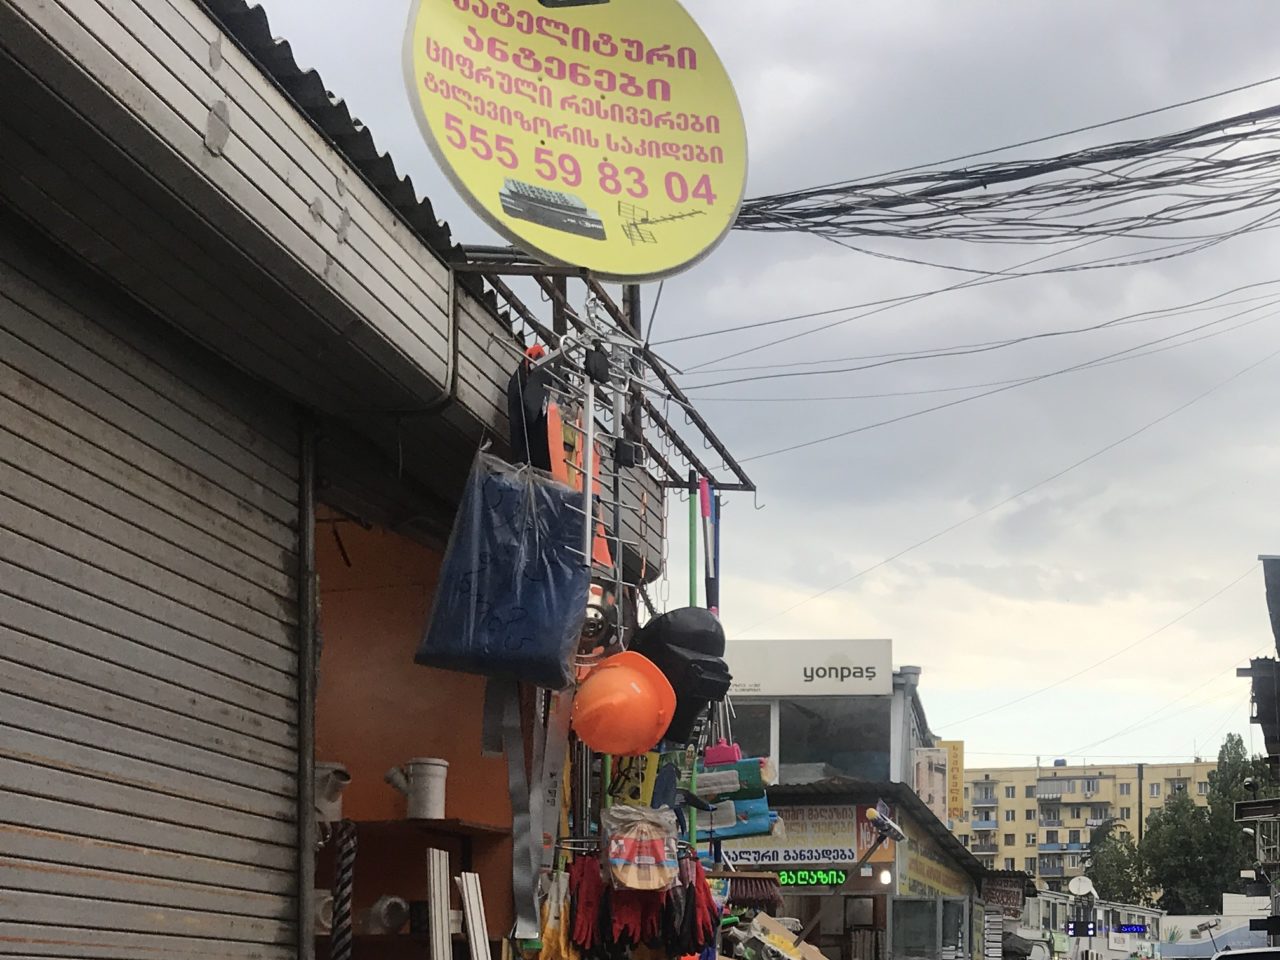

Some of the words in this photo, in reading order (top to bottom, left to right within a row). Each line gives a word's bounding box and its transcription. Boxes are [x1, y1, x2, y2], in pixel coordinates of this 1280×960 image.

[425, 36, 553, 109] ციფრული
[560, 94, 721, 135] რესივერები
[463, 25, 672, 102] ანტენები
[423, 71, 599, 150] ტელევიზორის
[606, 133, 724, 165] საკიდები
[444, 112, 519, 171] 555
[535, 147, 583, 189] 59
[598, 161, 650, 200] 83
[664, 170, 718, 206] 04
[802, 665, 877, 682] yonpaş
[779, 870, 846, 885] მაღაზია
[783, 849, 855, 862] განვადება
